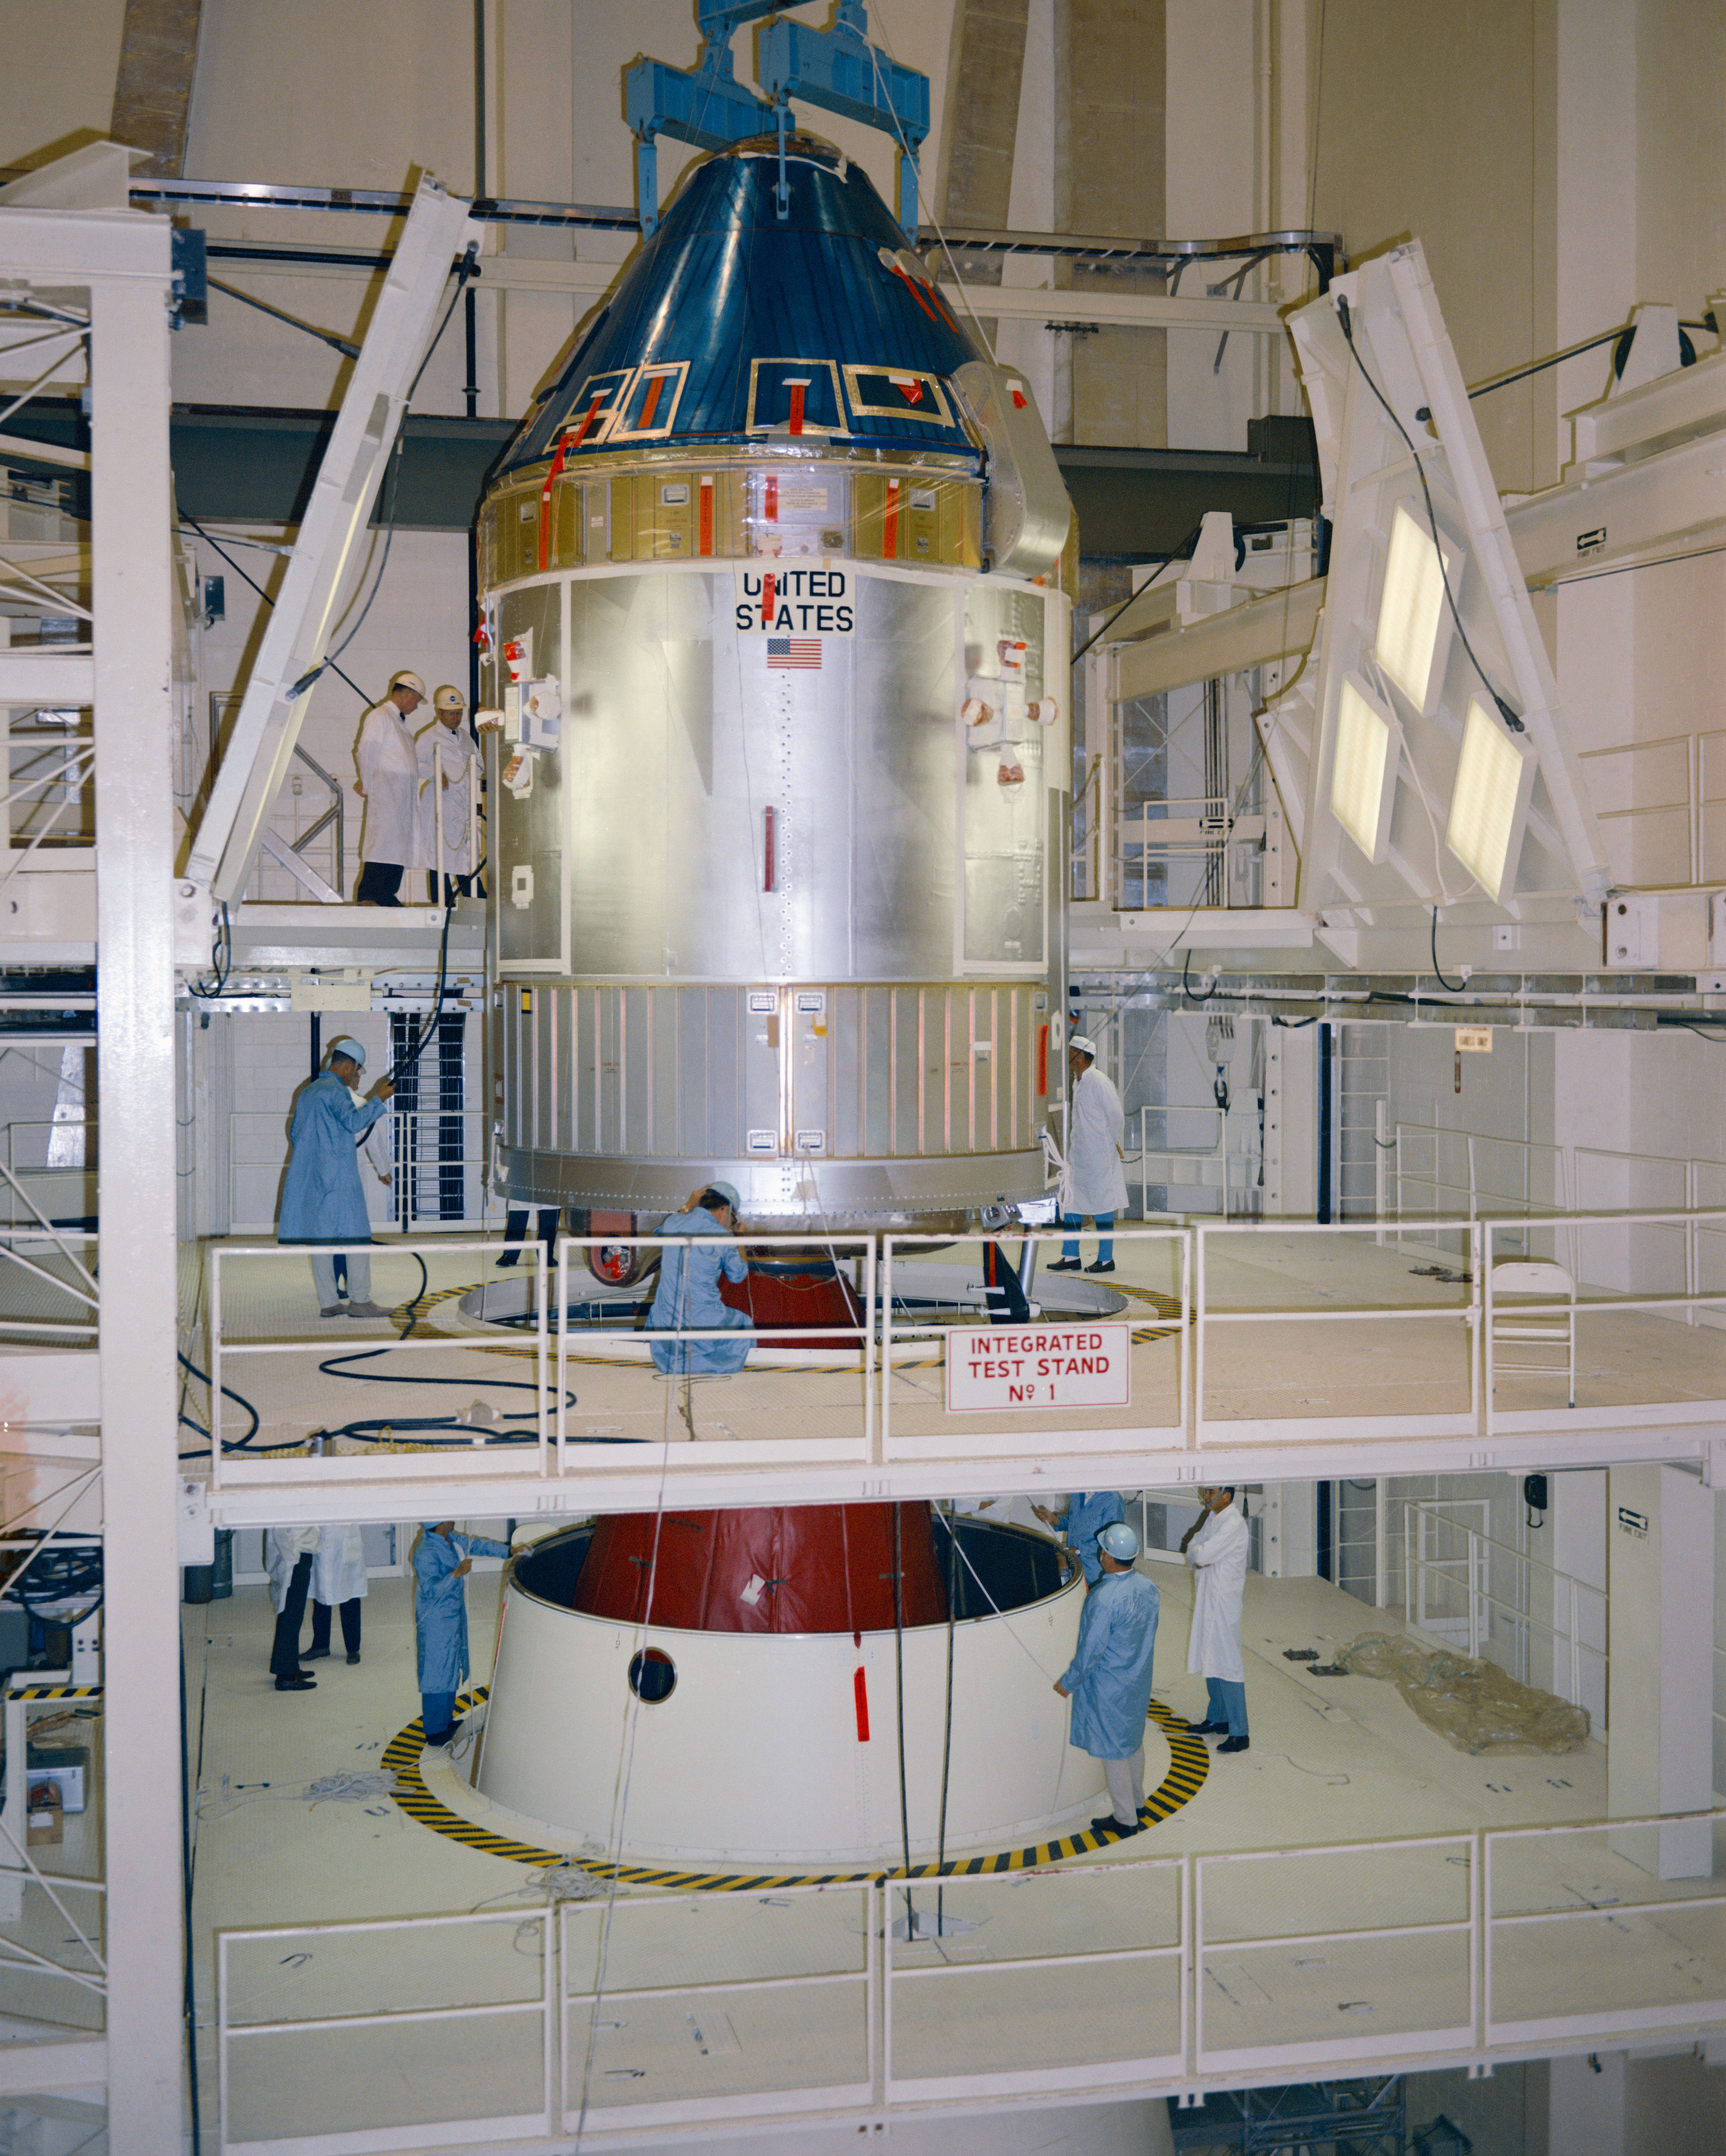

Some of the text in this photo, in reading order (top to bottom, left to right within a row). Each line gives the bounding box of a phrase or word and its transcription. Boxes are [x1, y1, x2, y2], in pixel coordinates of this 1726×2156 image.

[971, 1334, 1102, 1354] INTEGRATED
[968, 1356, 1110, 1378] TEST STAND
[1049, 1383, 1054, 1400] 1
